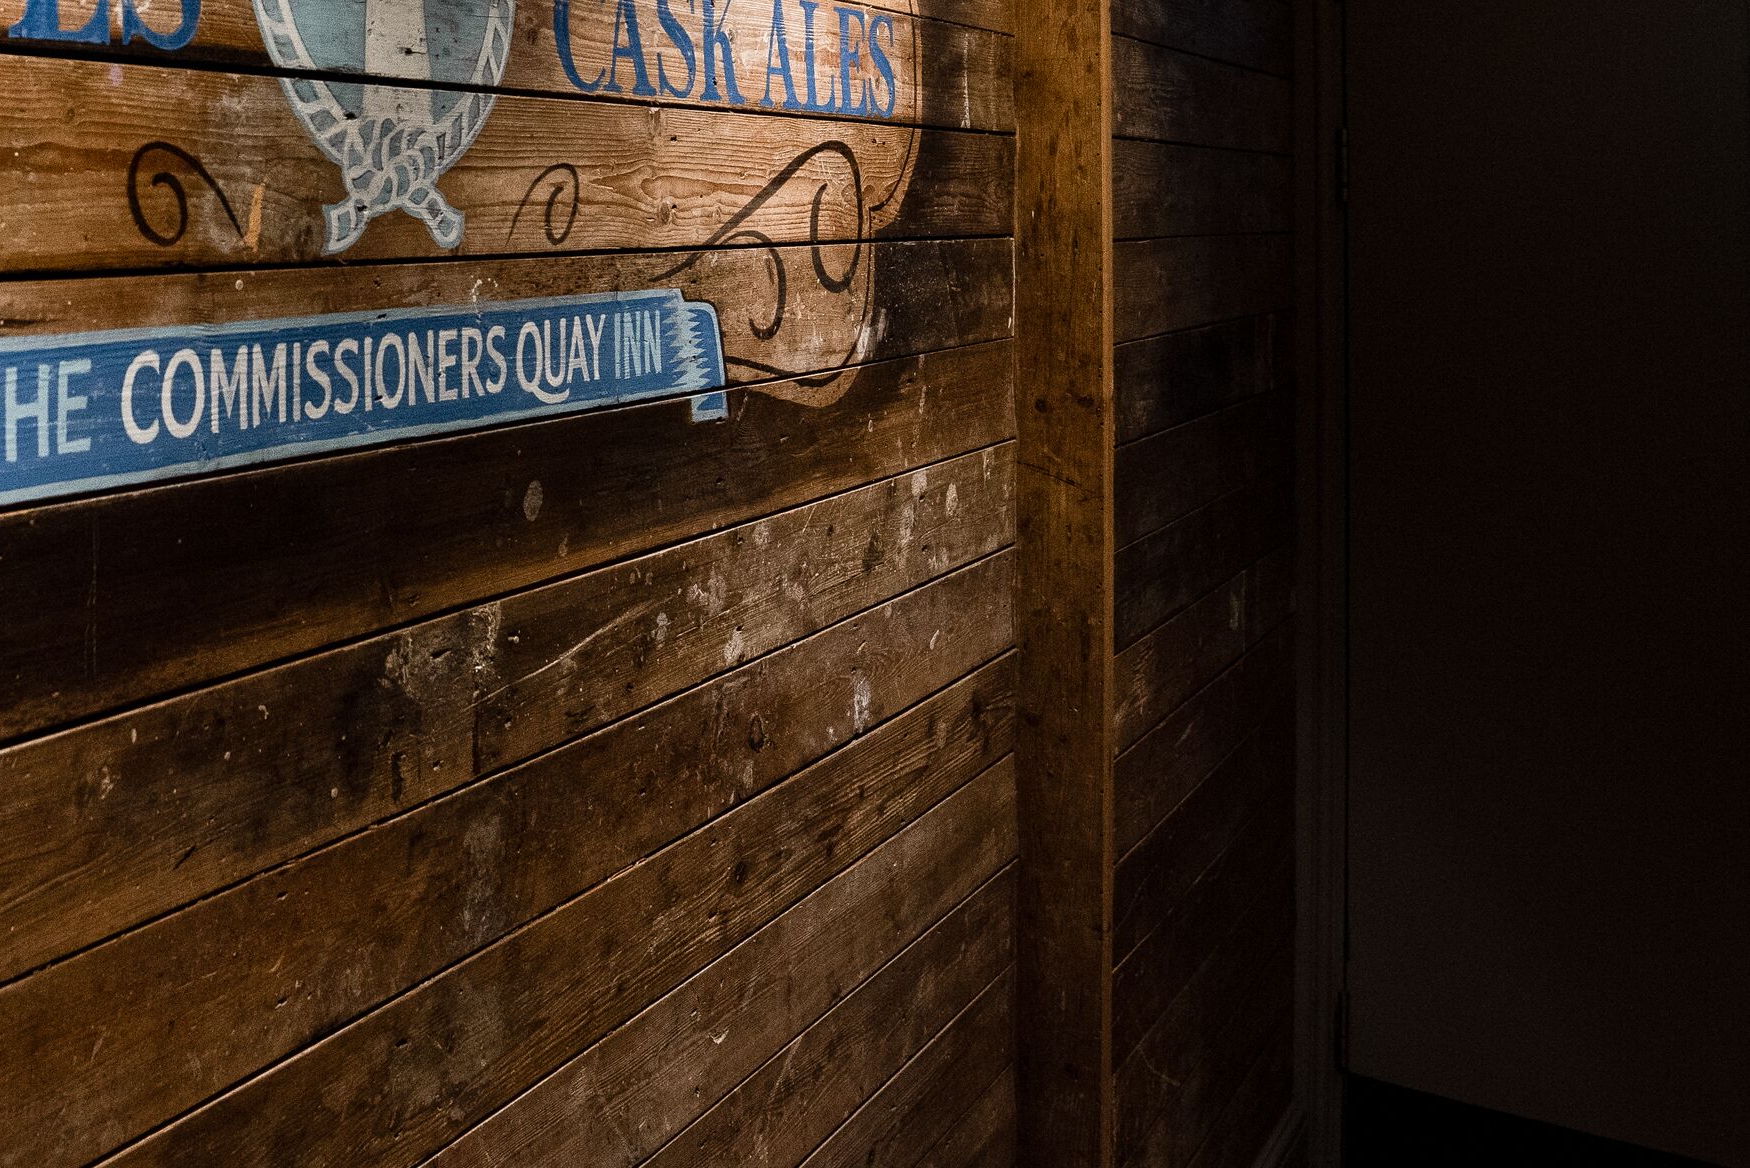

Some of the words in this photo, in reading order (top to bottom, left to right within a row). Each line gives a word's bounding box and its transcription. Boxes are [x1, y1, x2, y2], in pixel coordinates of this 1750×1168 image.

[120, 325, 507, 445] COMMISSIONERS
[516, 314, 607, 404] QUAY
[614, 310, 662, 380] INN
